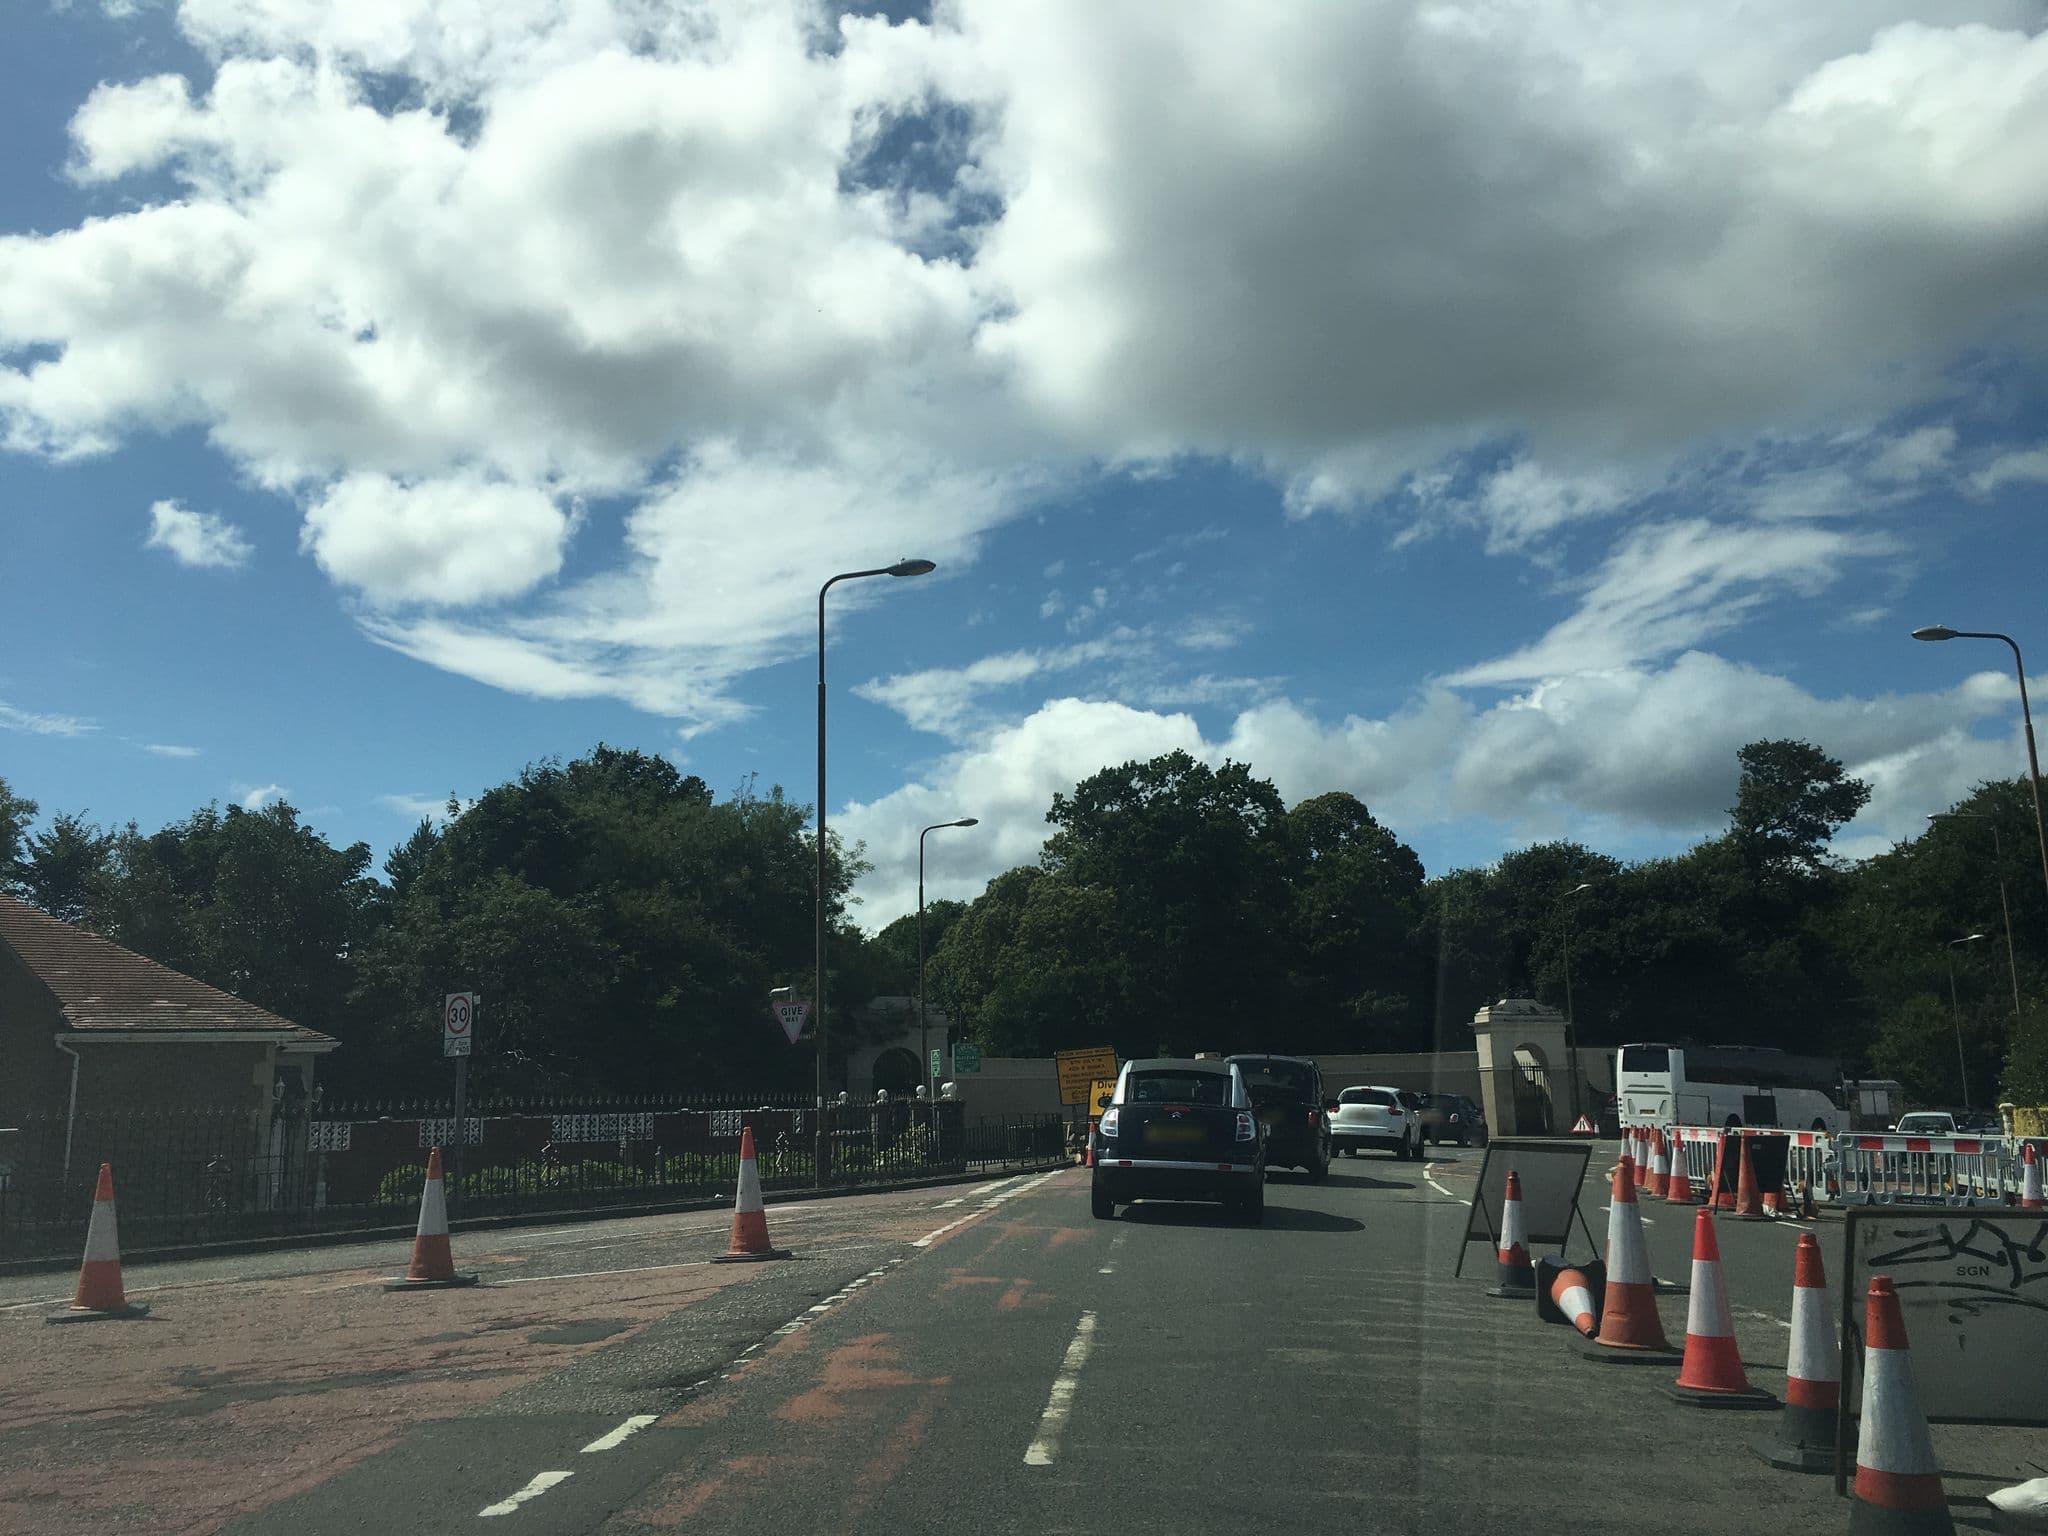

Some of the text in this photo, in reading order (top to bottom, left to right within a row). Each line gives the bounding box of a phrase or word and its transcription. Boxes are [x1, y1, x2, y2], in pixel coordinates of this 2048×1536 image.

[450, 1006, 467, 1023] 30
[781, 1007, 803, 1016] GIVE
[1956, 1266, 1989, 1276] SGN
